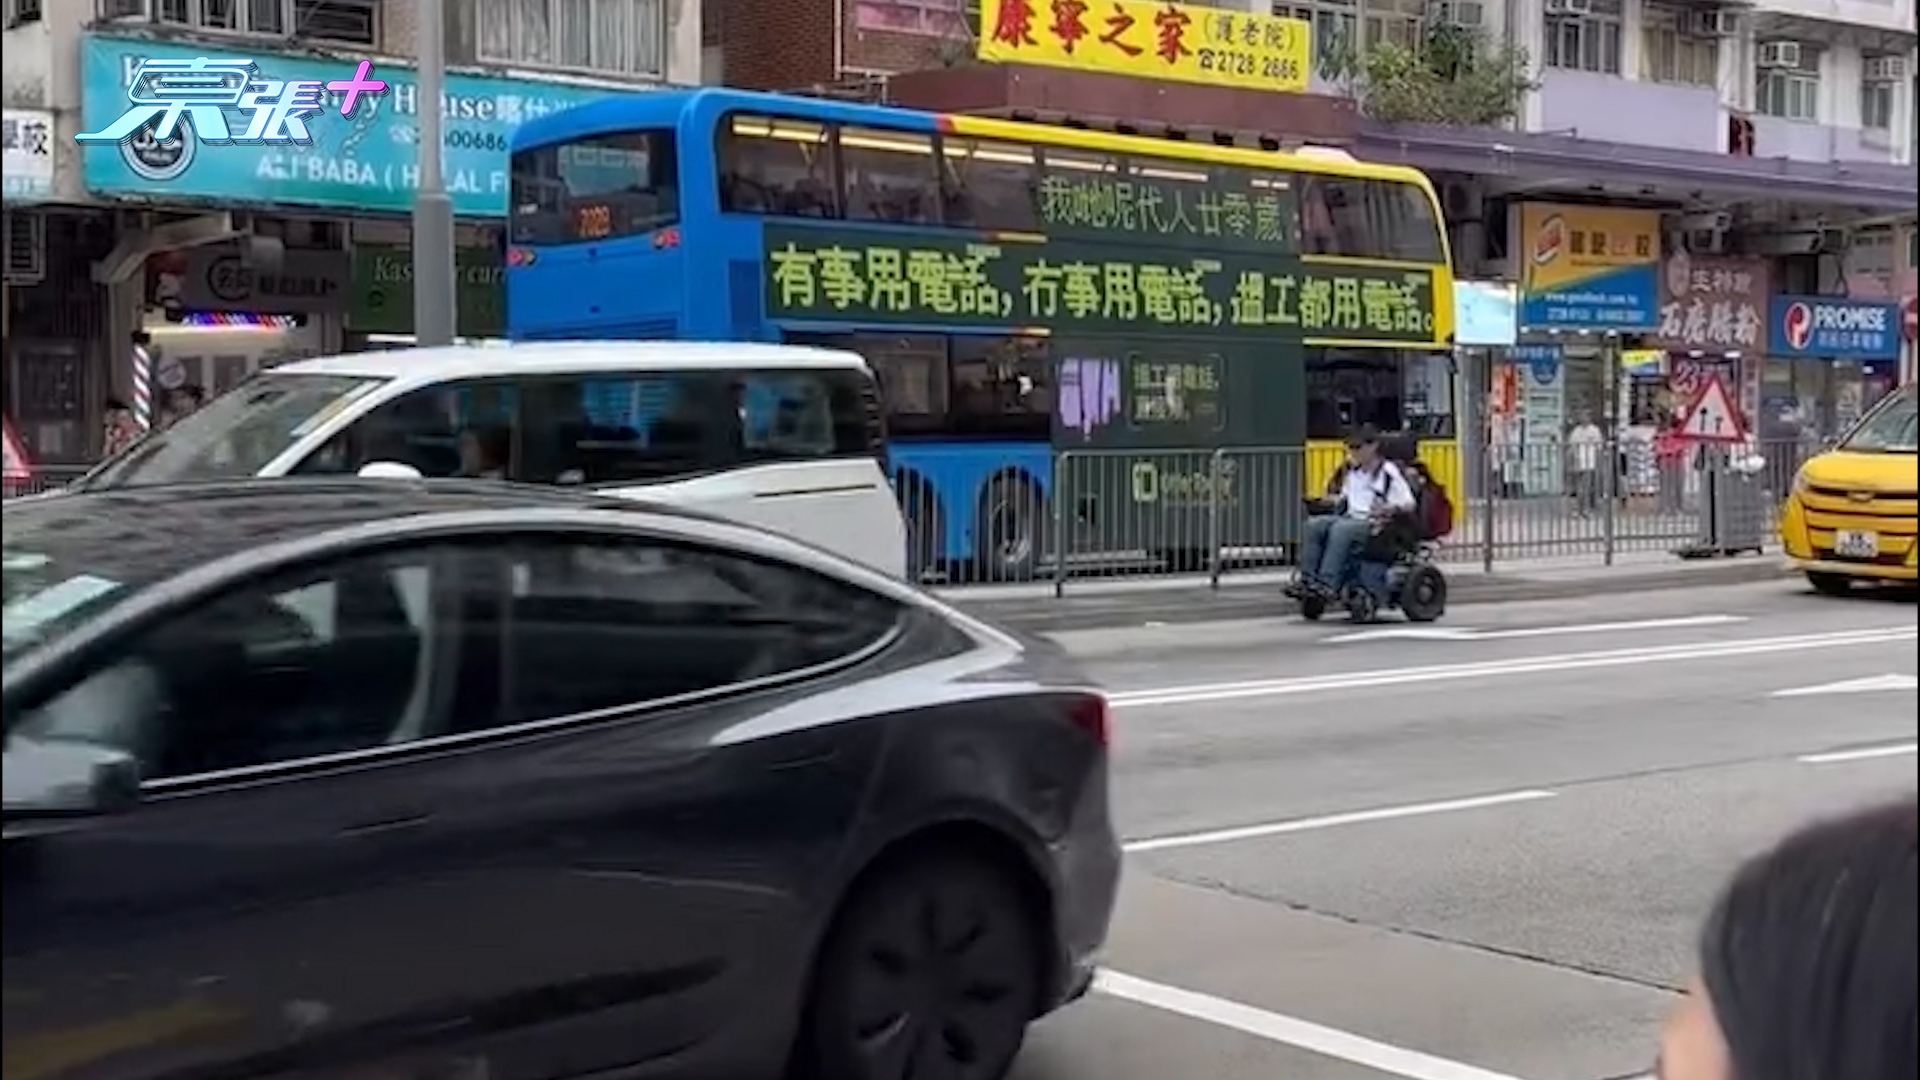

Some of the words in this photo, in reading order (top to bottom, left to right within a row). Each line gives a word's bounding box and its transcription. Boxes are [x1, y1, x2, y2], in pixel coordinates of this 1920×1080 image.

[991, 0, 1193, 64] 康寧之家
[394, 84, 494, 121] Huse
[308, 157, 377, 187] BABA
[1814, 304, 1886, 331] PROMISE
